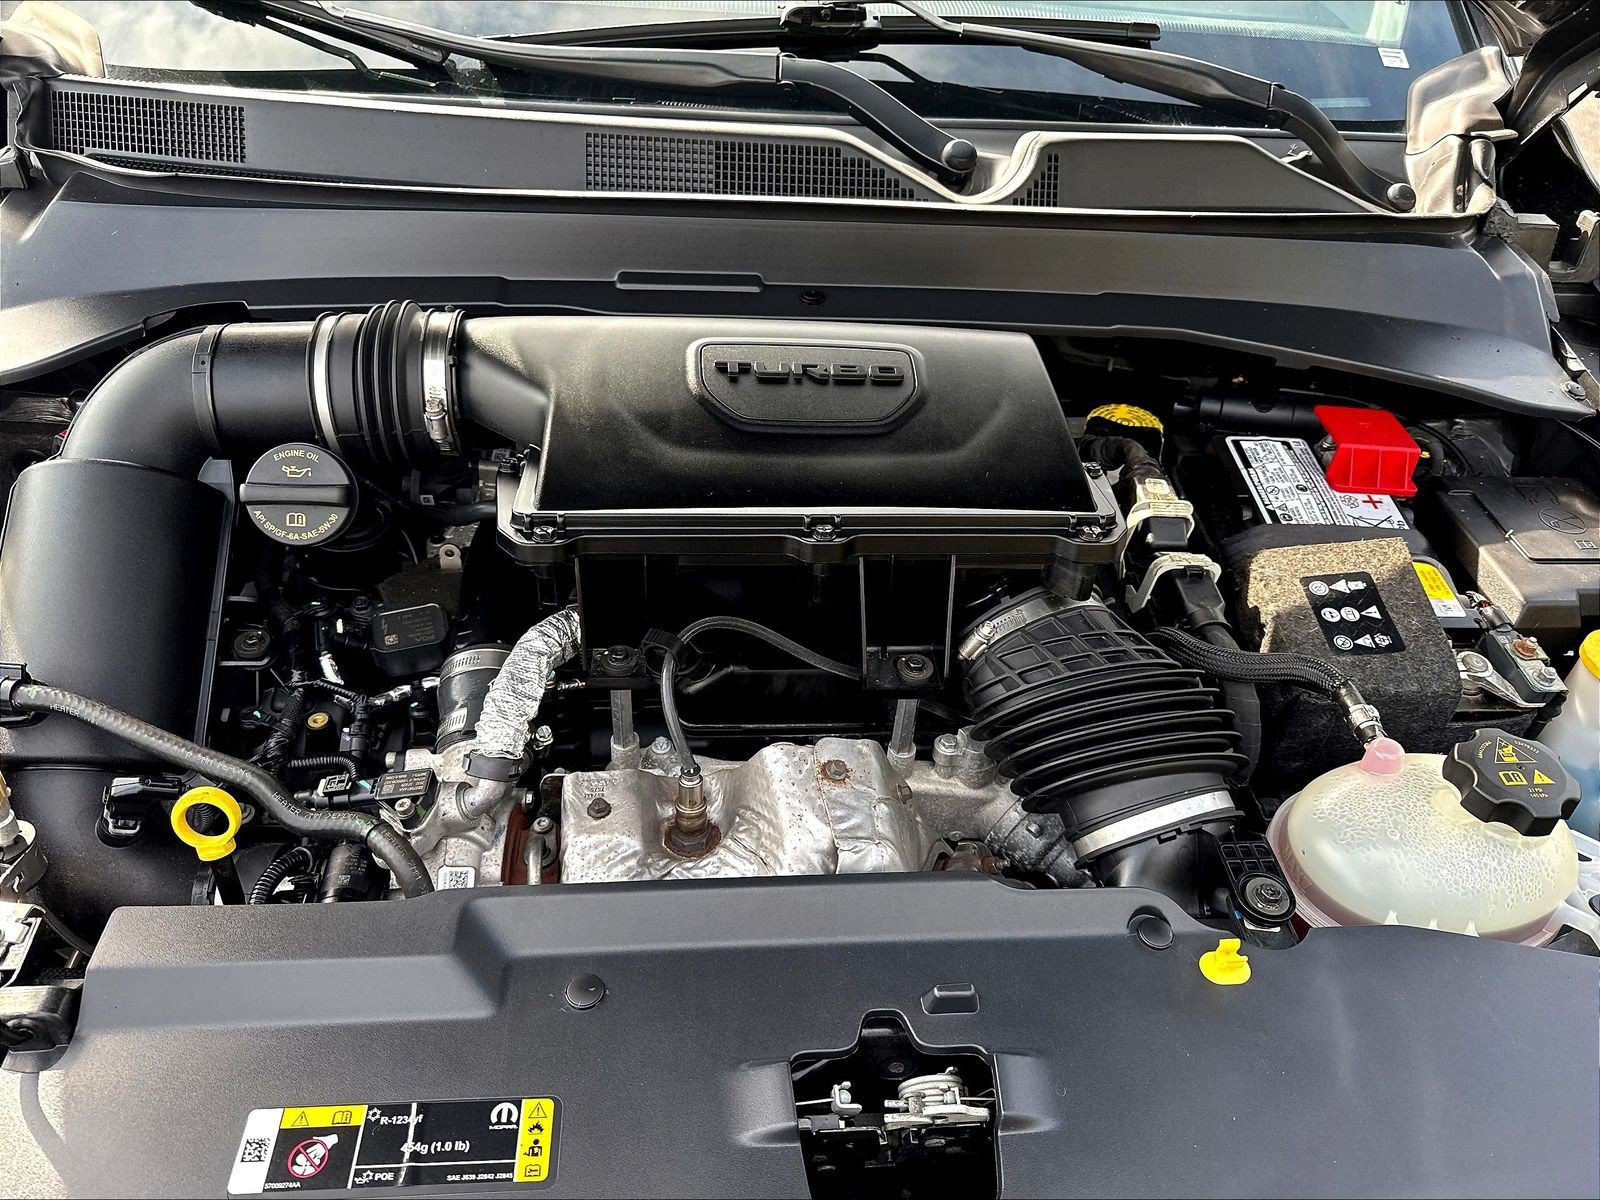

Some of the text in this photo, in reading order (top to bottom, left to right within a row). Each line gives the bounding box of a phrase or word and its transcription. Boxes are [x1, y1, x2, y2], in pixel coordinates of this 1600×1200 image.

[714, 360, 905, 384] TURBO
[273, 449, 320, 463] ENGINE OIL
[253, 510, 266, 524] API
[50, 703, 80, 717] HEATER
[271, 791, 302, 817] HEATER
[430, 1140, 453, 1155] (1.0
[454, 1140, 470, 1153] lb)
[374, 1172, 395, 1181] POE
